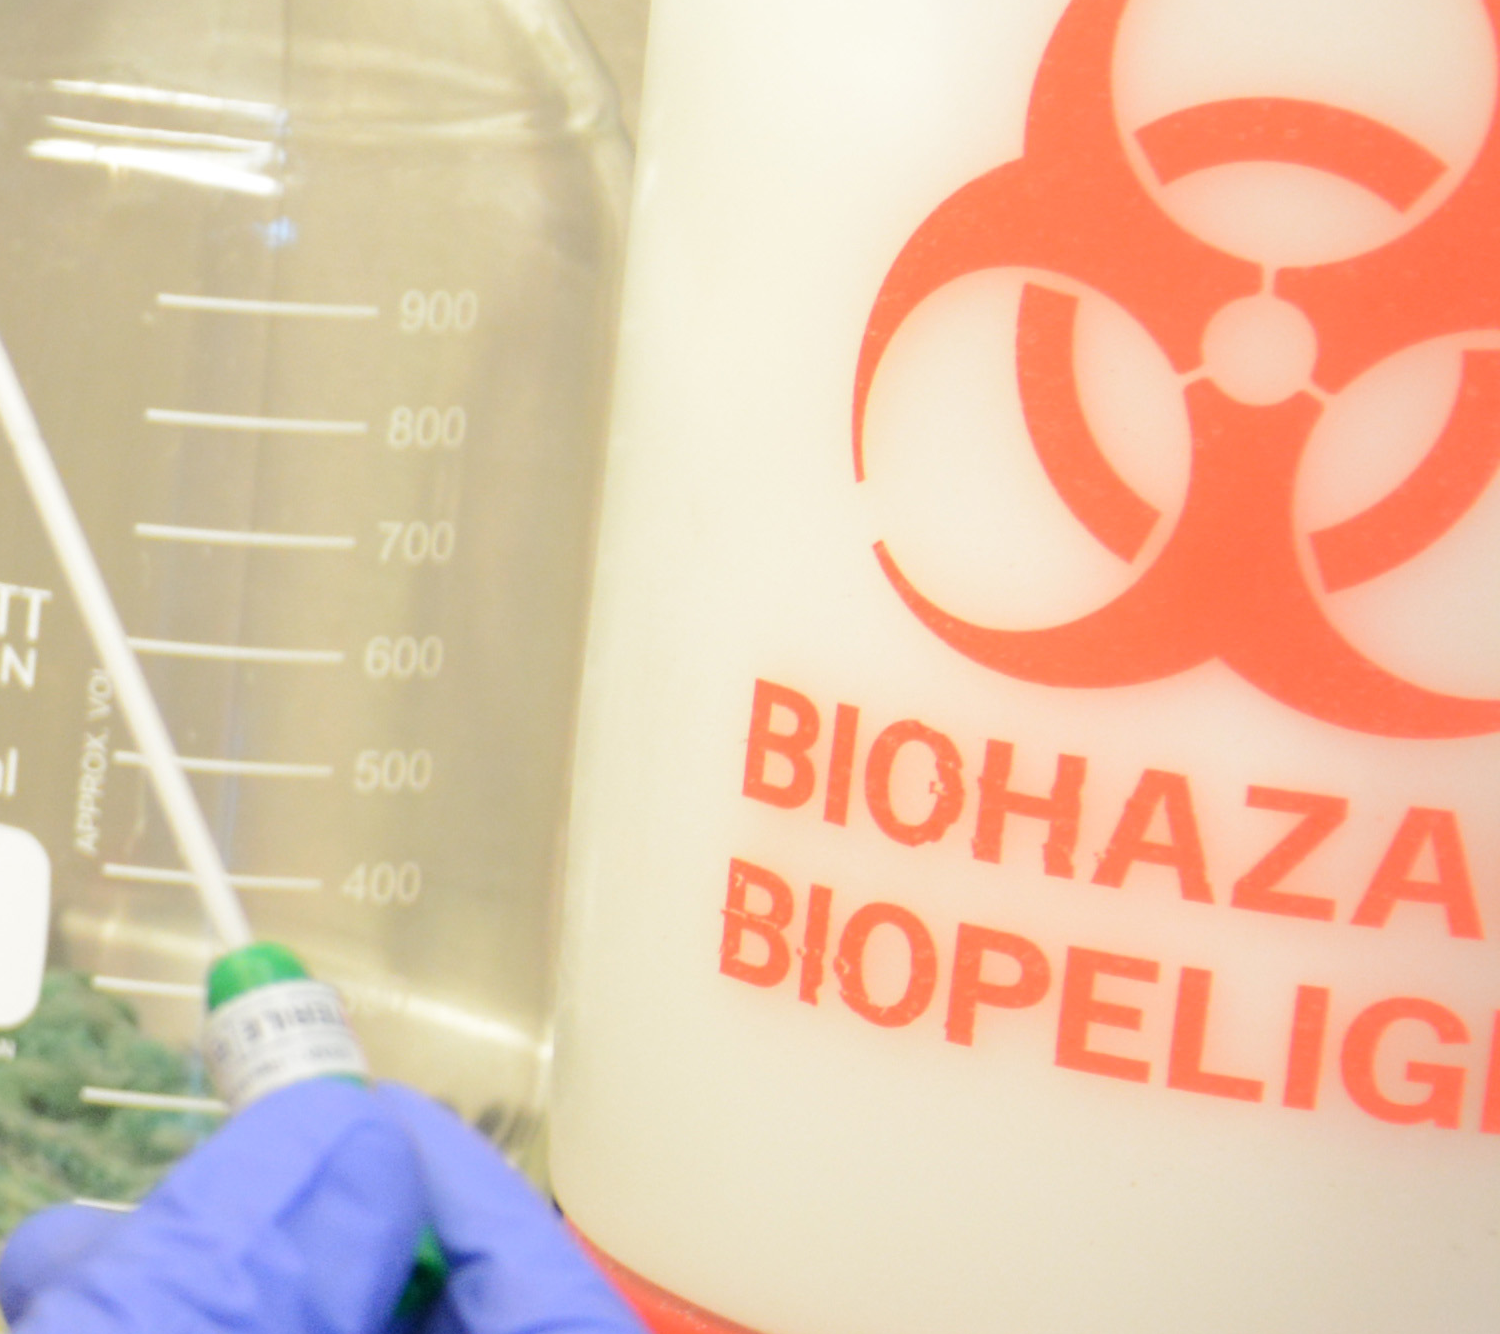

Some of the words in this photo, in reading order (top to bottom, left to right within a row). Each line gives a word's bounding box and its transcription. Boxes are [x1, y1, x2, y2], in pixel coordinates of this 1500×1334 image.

[399, 290, 479, 332] 900
[386, 406, 467, 449] 800
[376, 522, 456, 564] 700
[364, 637, 444, 678] 600
[353, 750, 433, 792] 500
[341, 864, 422, 905] 400
[718, 856, 1500, 1134] BIOPELIG
